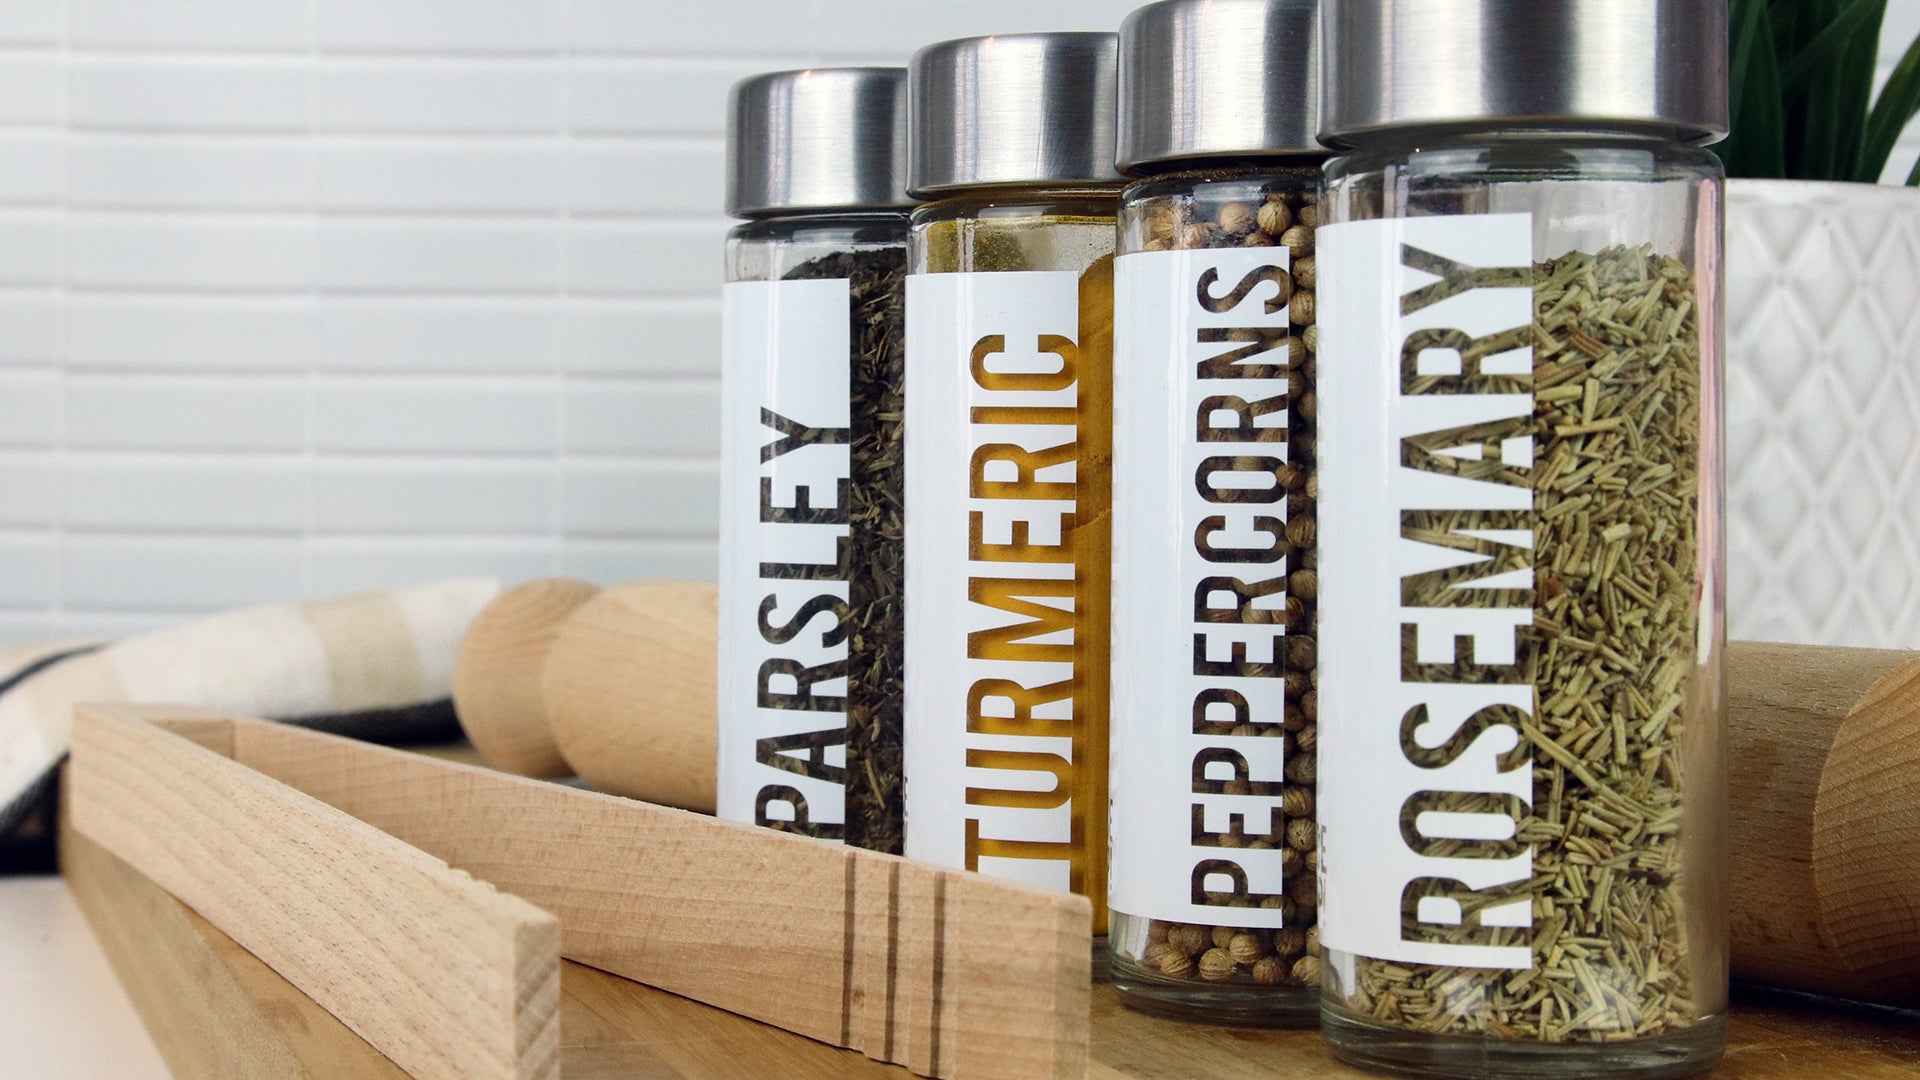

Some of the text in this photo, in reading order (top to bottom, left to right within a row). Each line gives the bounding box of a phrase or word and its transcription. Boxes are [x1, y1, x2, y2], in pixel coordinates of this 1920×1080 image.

[755, 406, 850, 839] PARSLEY
[965, 334, 1078, 872] TURMERIC
[1191, 264, 1289, 908] PEPPERCORNS
[1400, 242, 1532, 947] ROSEMARY
